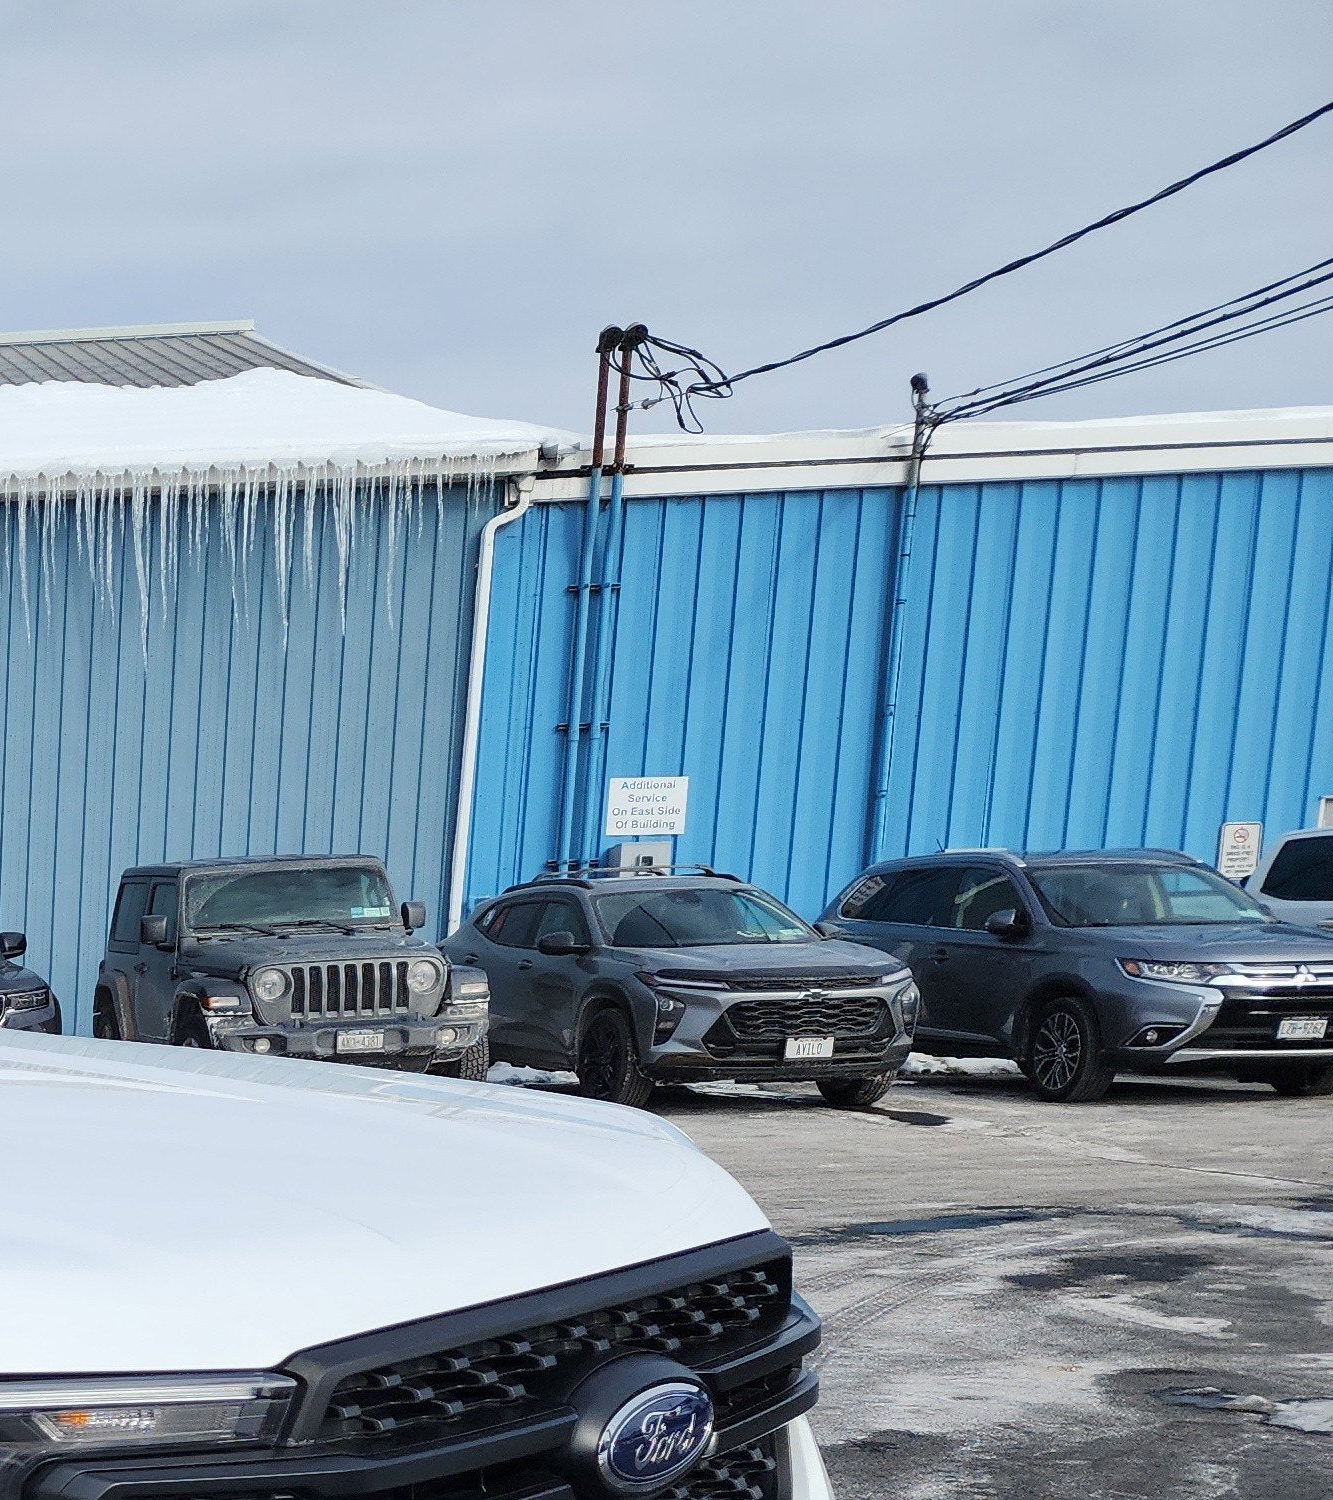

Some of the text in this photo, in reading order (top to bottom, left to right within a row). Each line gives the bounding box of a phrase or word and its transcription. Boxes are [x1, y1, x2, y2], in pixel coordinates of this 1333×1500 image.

[621, 780, 676, 790] Additional
[628, 793, 667, 803] Service
[612, 806, 681, 817] On East Side
[615, 819, 675, 830] Of Building
[635, 1405, 697, 1471] Ford
